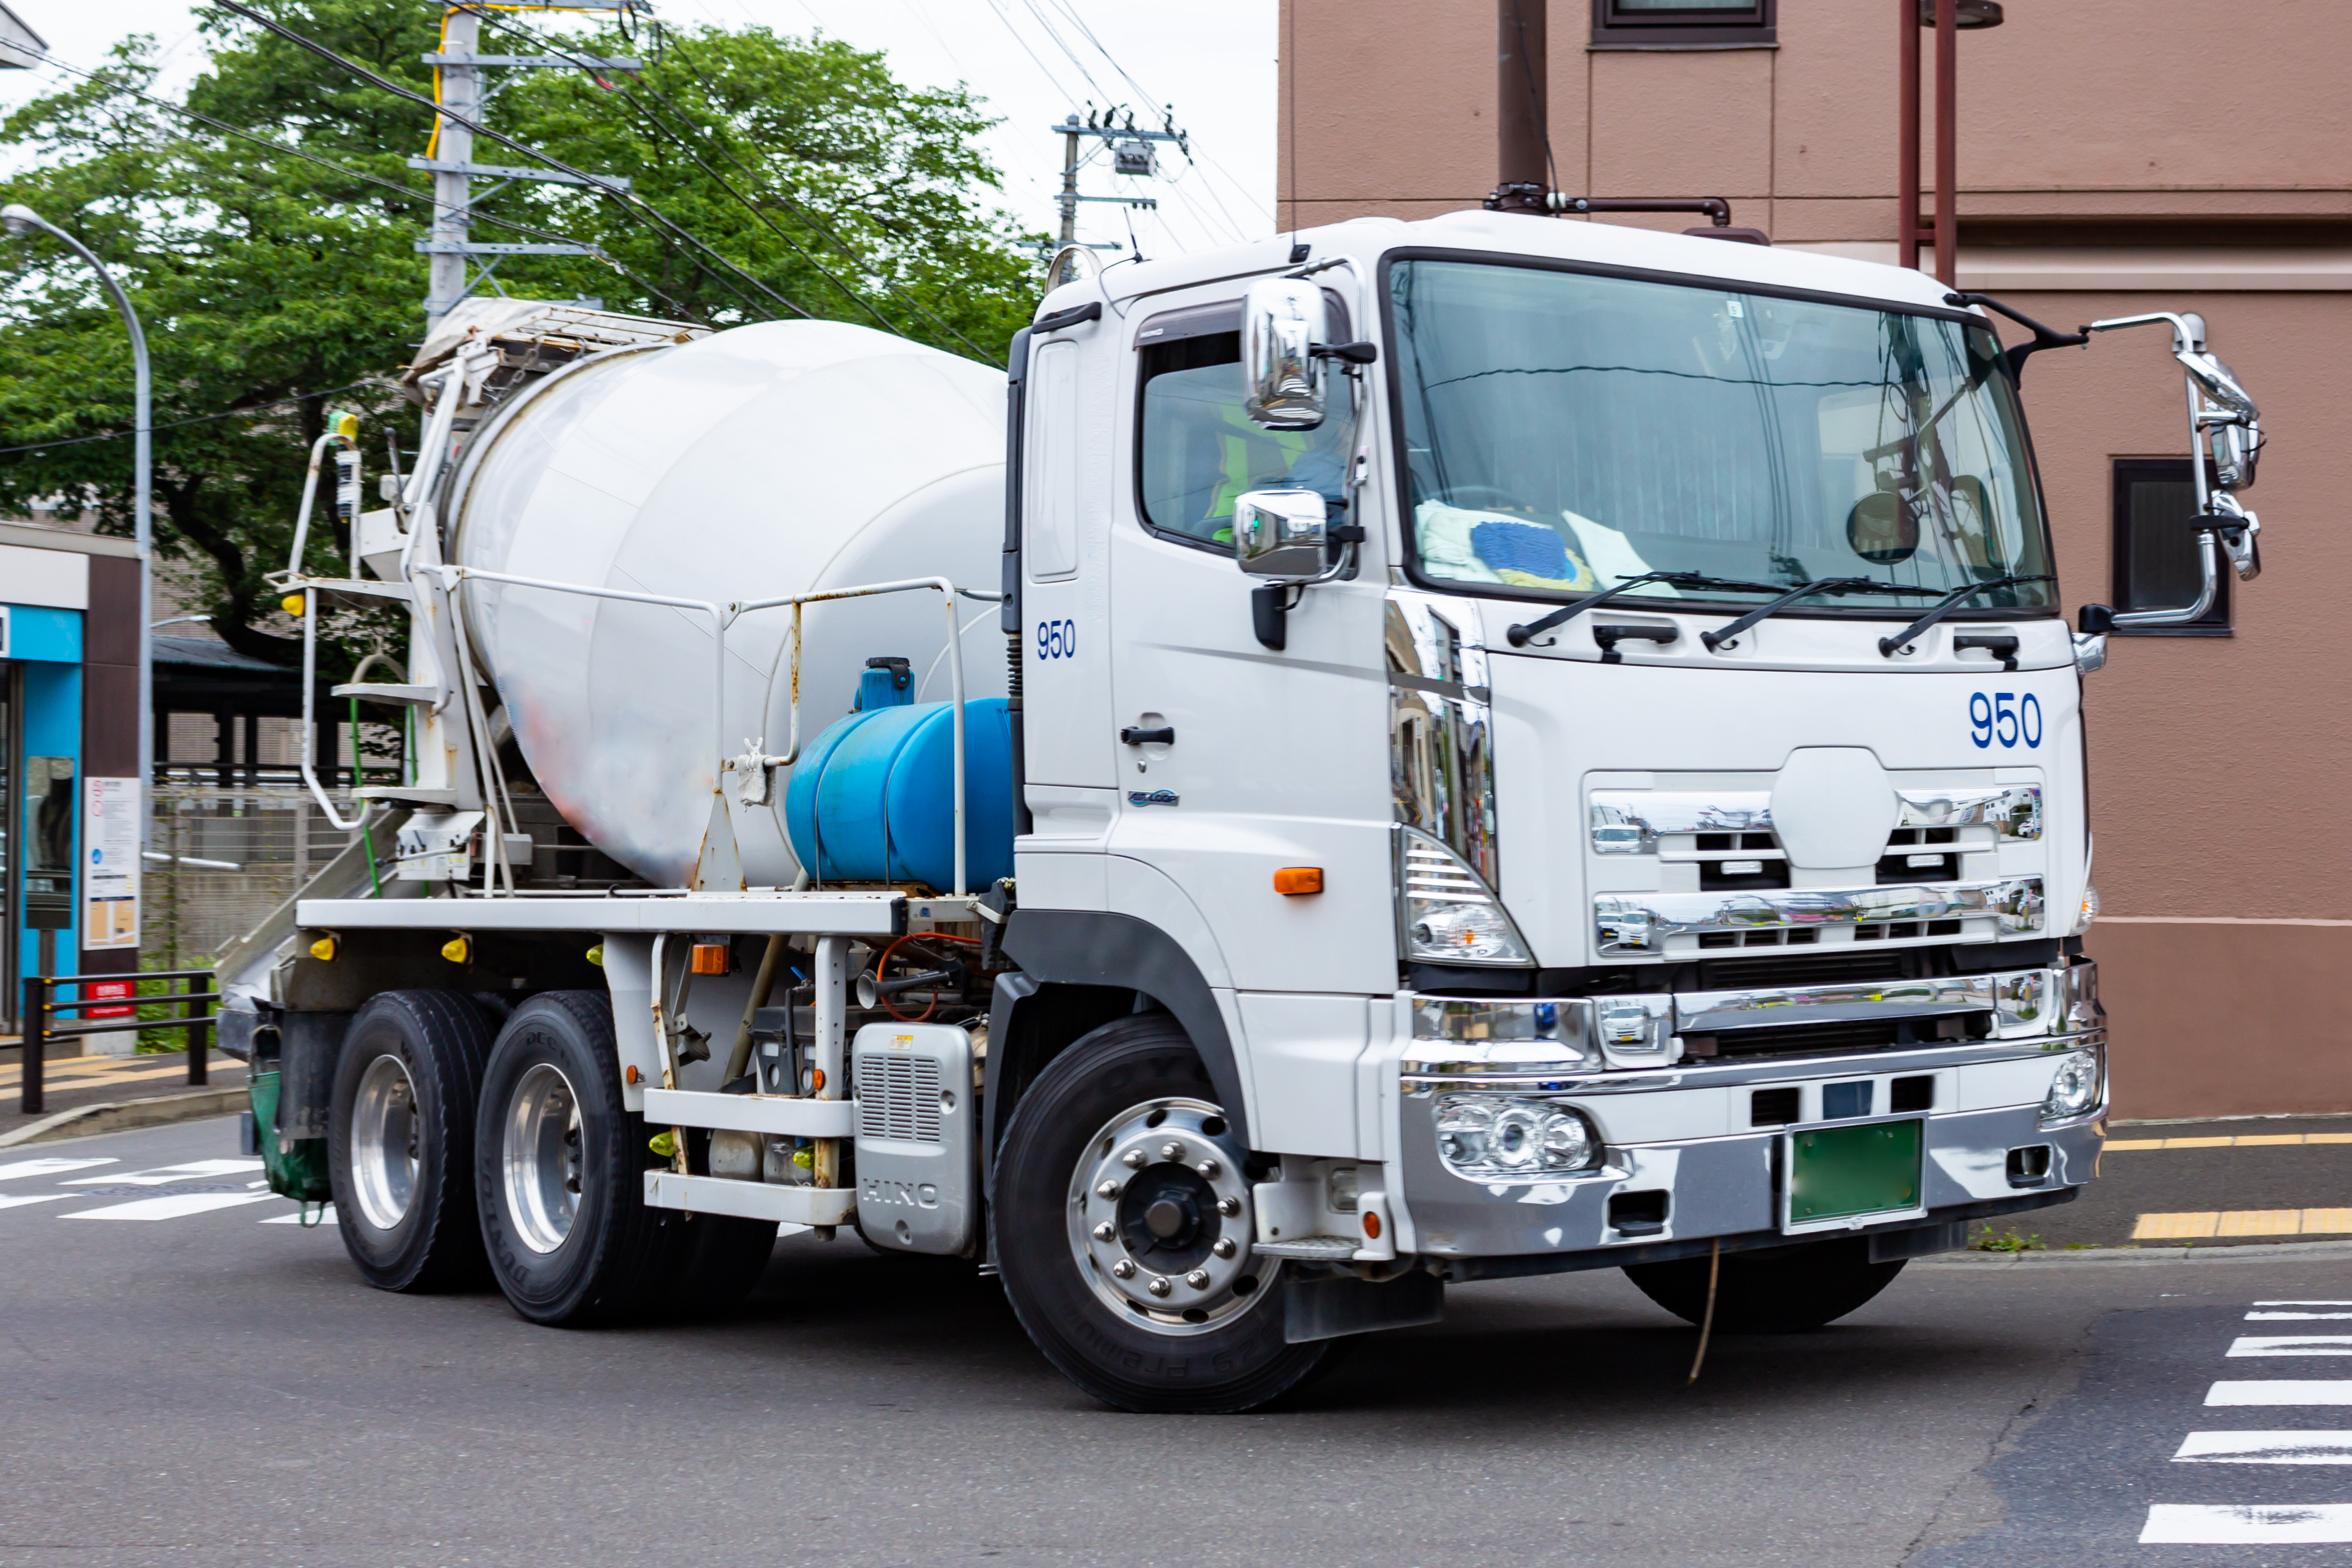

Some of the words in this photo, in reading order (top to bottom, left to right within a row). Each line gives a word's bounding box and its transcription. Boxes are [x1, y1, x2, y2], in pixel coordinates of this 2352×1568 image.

[1038, 619, 1075, 660] 950
[1970, 692, 2042, 748] 950
[863, 1177, 939, 1210] HINO
